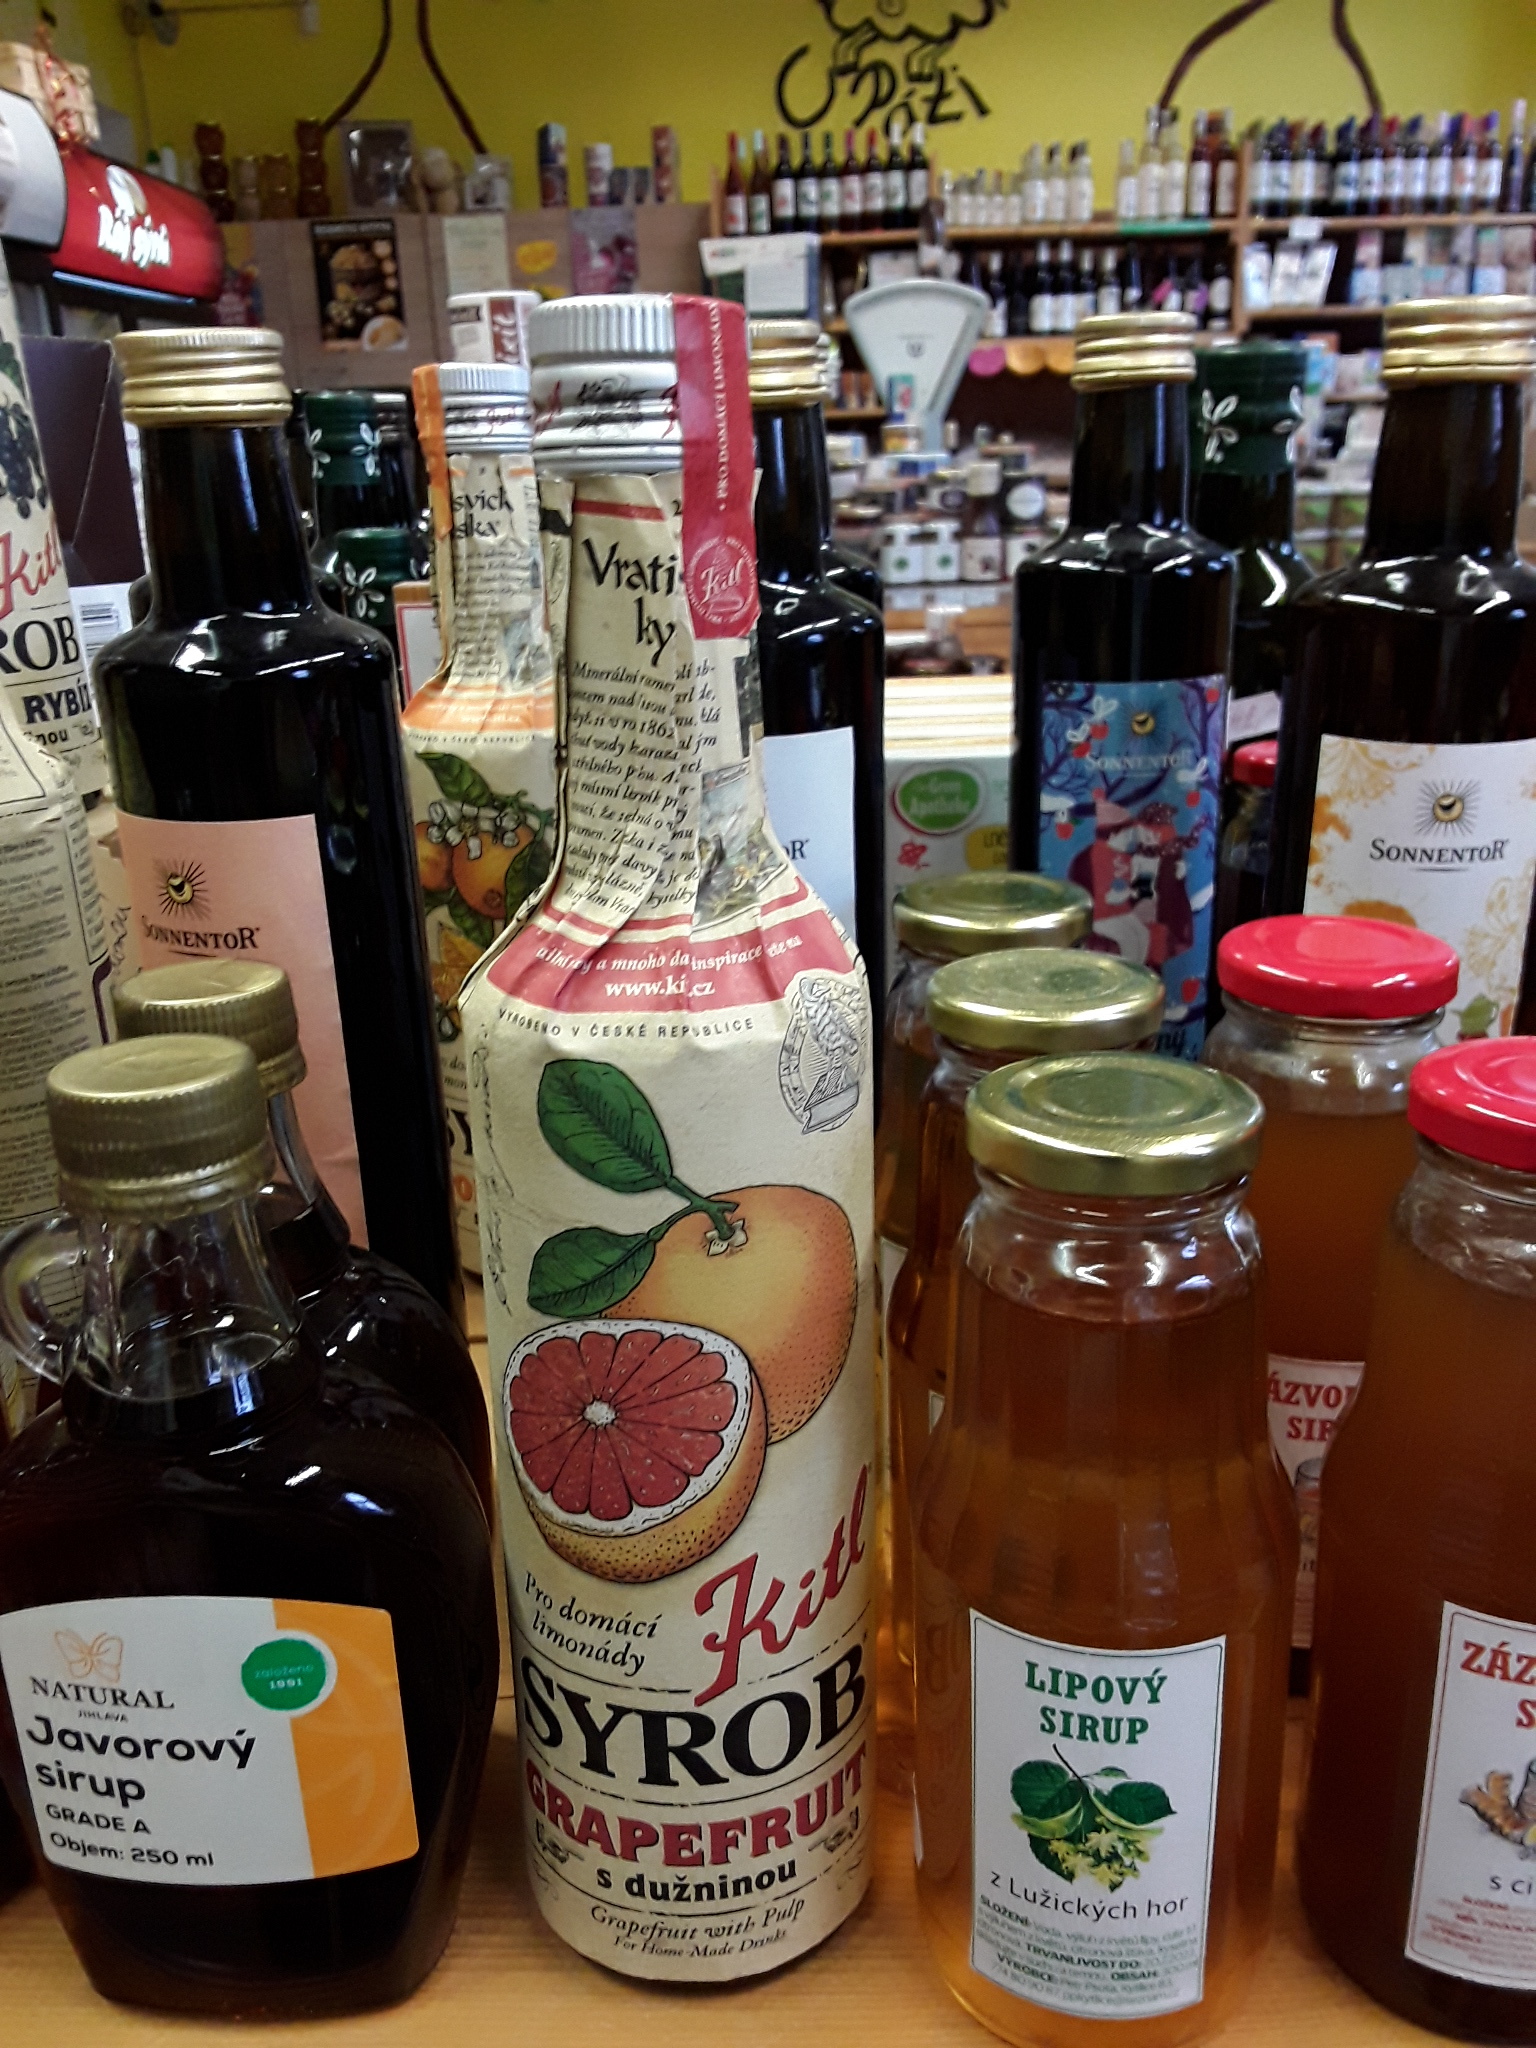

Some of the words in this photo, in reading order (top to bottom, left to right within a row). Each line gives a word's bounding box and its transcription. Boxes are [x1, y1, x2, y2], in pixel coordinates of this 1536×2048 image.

[1369, 837, 1509, 864] SONNENTOR
[590, 1022, 647, 1037] ČESKÉ
[524, 1570, 555, 1610] Pro
[559, 1599, 664, 1639] domácí
[693, 1463, 867, 1708] Kitl
[531, 1610, 646, 1677] limonády
[29, 1676, 175, 1709] NATURAL
[1025, 1660, 1168, 1705] LIPOVÝ
[520, 1643, 866, 1787] SYROB
[1040, 1705, 1149, 1744] SIRUP
[26, 1714, 257, 1770] Javorový
[35, 1760, 147, 1808] sirup
[525, 1740, 867, 1868] GRAPEFRUIT
[45, 1803, 127, 1833] GRADE
[132, 1819, 152, 1835] A
[50, 1832, 125, 1861] Objem:
[130, 1847, 179, 1866] 250
[185, 1853, 215, 1867] ml
[597, 1867, 612, 1889] s
[624, 1859, 798, 1902] dužninou
[990, 1871, 1000, 1887] z
[1009, 1877, 1137, 1923] Lužických
[1146, 1896, 1189, 1917] hor
[590, 1905, 699, 1942] Grapefruit
[704, 1915, 756, 1939] with
[762, 1898, 806, 1928] Pulp
